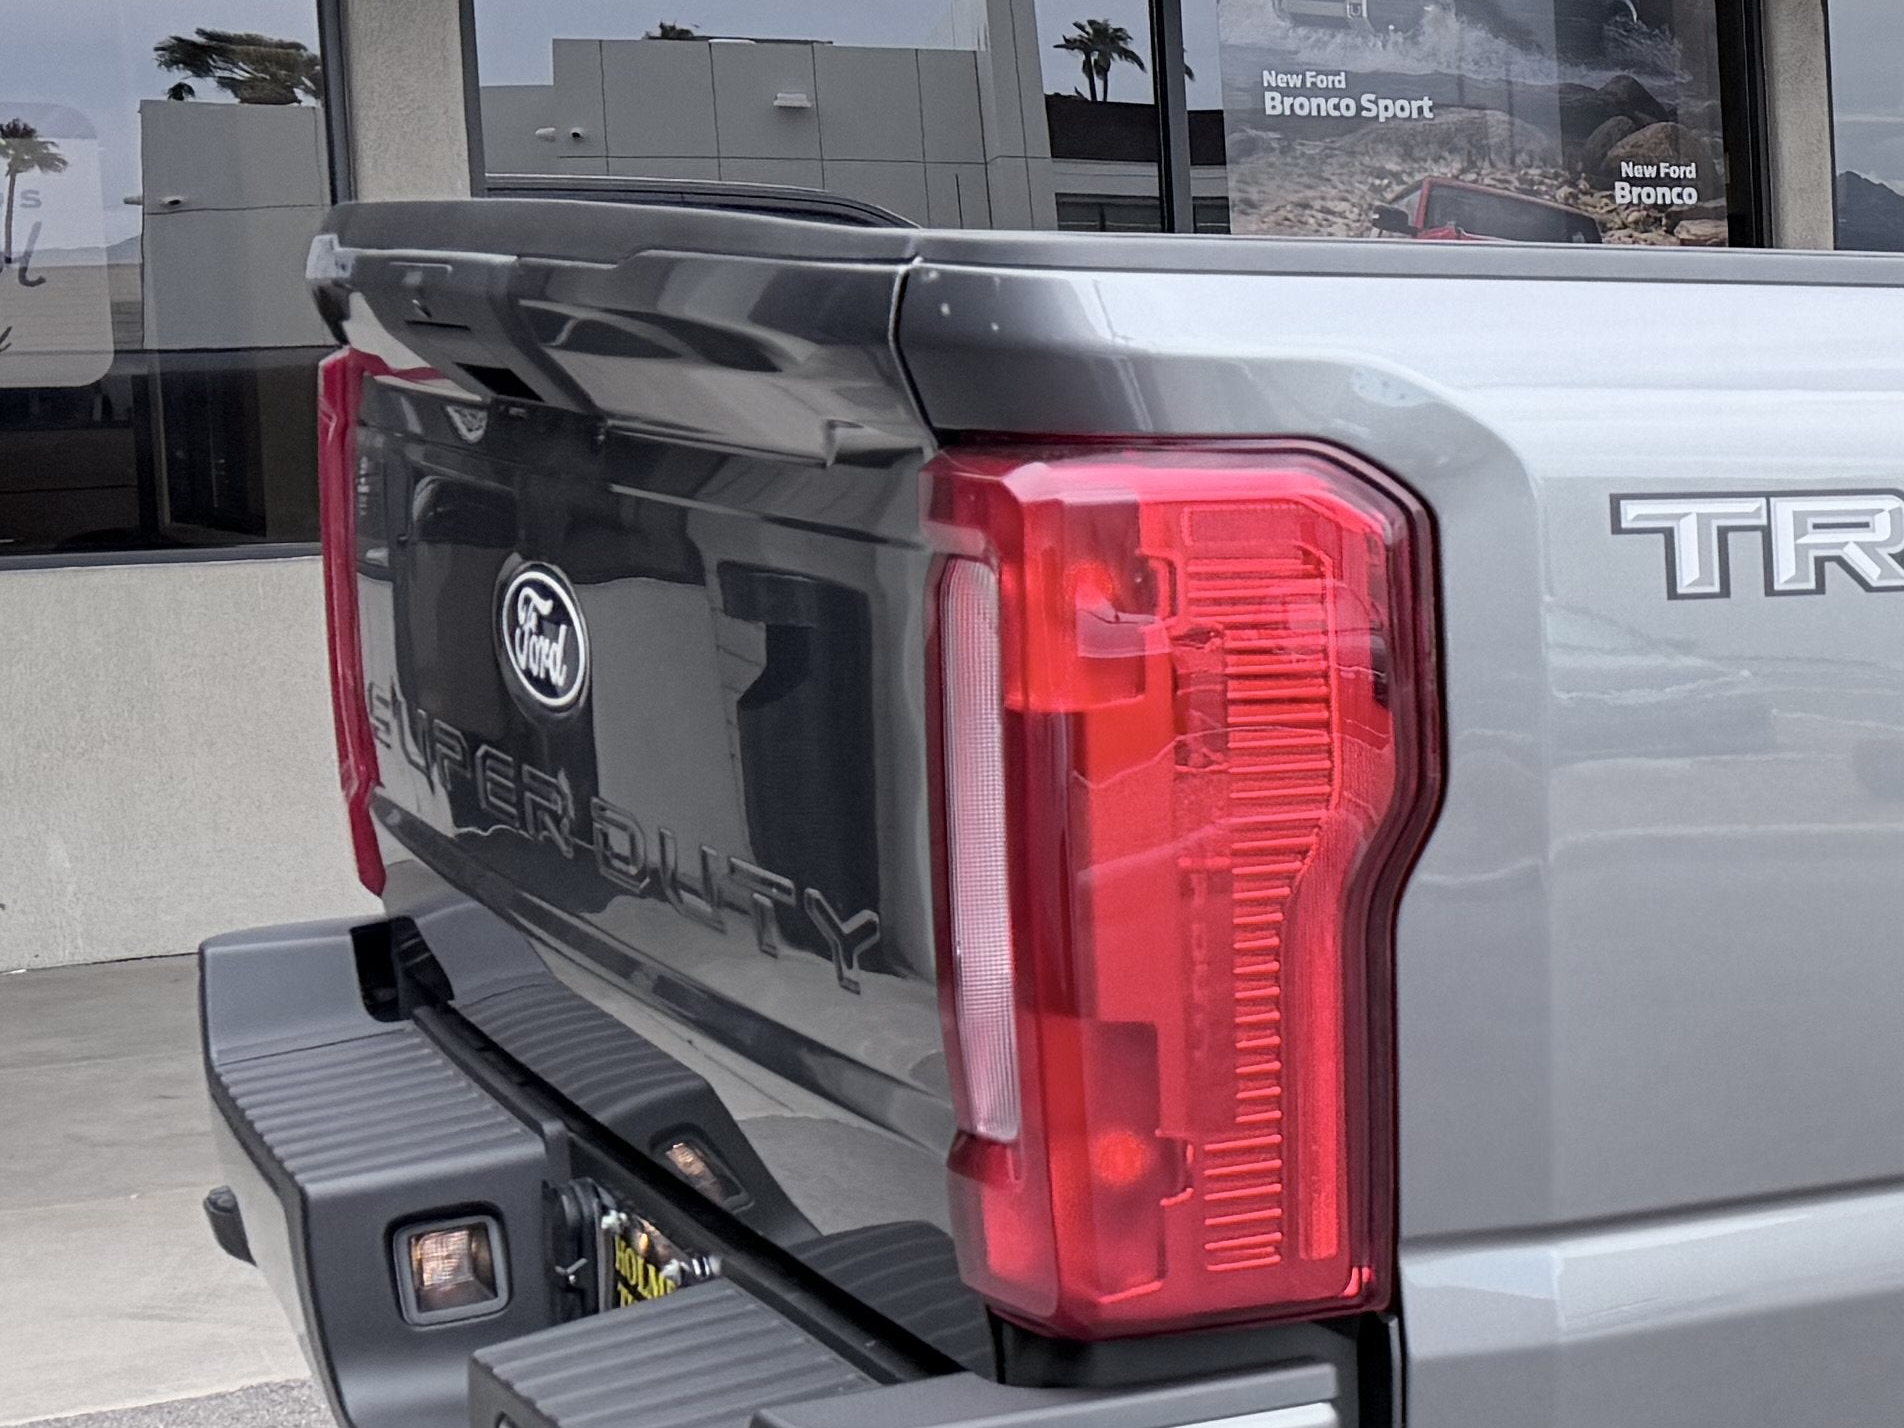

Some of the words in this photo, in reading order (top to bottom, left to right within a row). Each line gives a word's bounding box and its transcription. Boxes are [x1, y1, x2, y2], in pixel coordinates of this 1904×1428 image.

[1263, 70, 1302, 87] New
[1306, 71, 1346, 89] Ford
[1264, 91, 1356, 116] Bronco
[1360, 93, 1434, 122] Sport
[1621, 161, 1657, 178] New
[1660, 162, 1697, 179] Ford
[1615, 181, 1698, 205] Bronco
[368, 677, 573, 859] SUPER
[590, 795, 881, 995] DUTY
